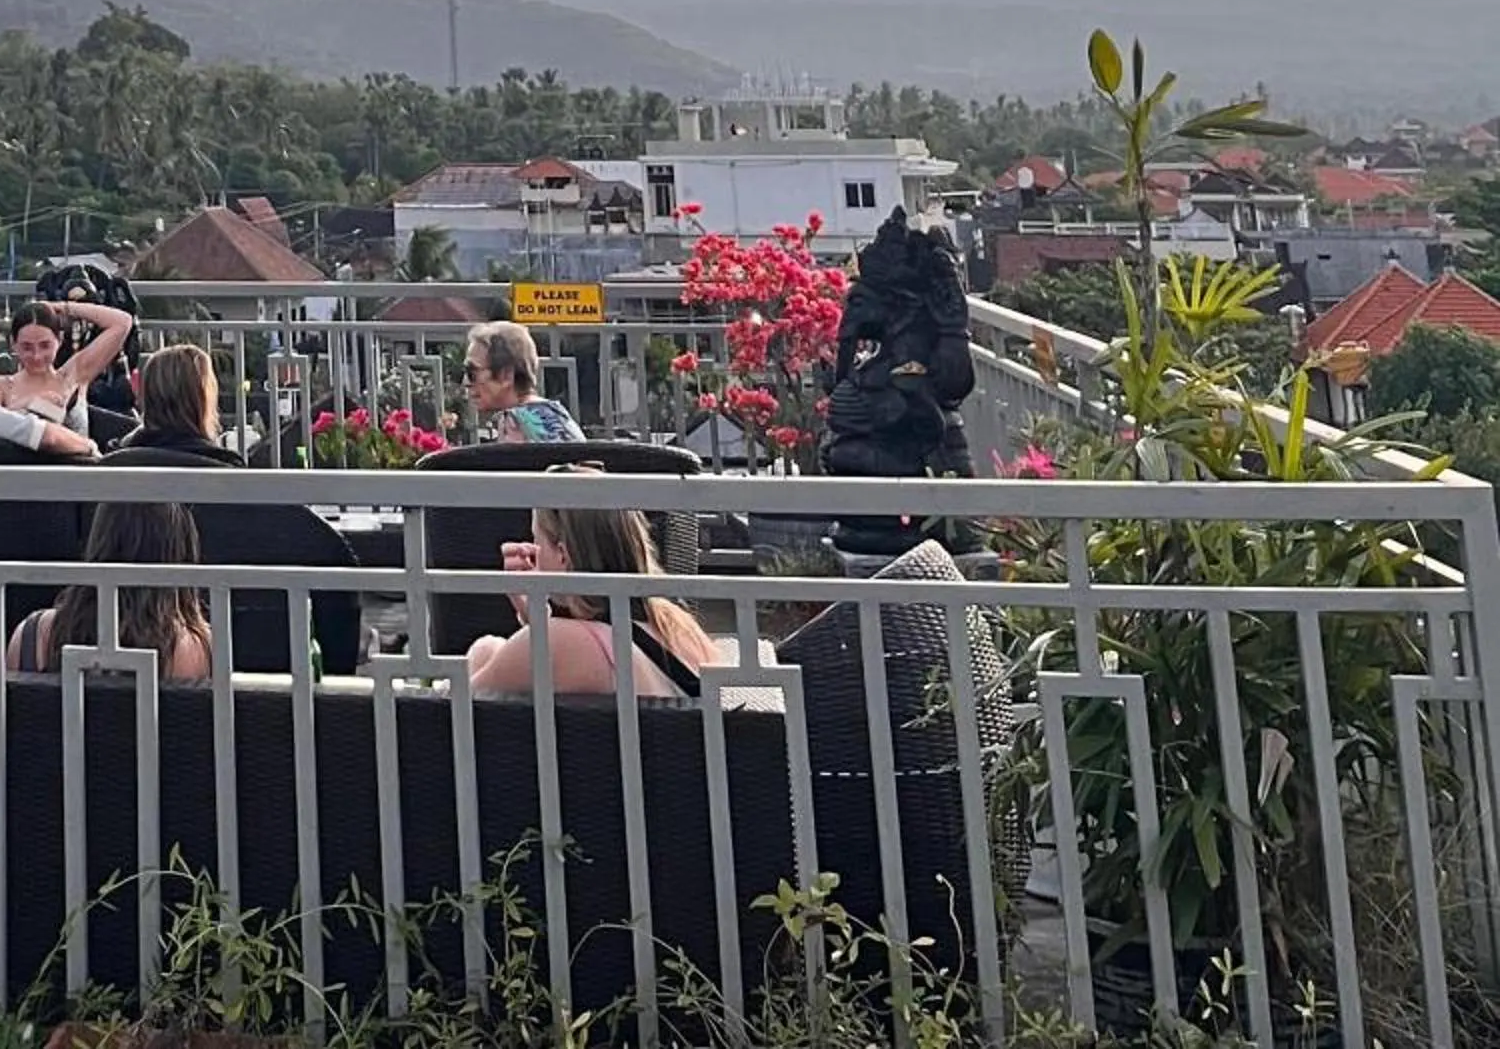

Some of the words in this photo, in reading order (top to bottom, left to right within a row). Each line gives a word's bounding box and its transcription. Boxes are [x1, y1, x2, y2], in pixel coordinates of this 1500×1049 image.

[533, 290, 580, 300] PLEASE
[518, 304, 534, 314] DO
[538, 304, 562, 315] NOT
[567, 304, 598, 315] LEAN
